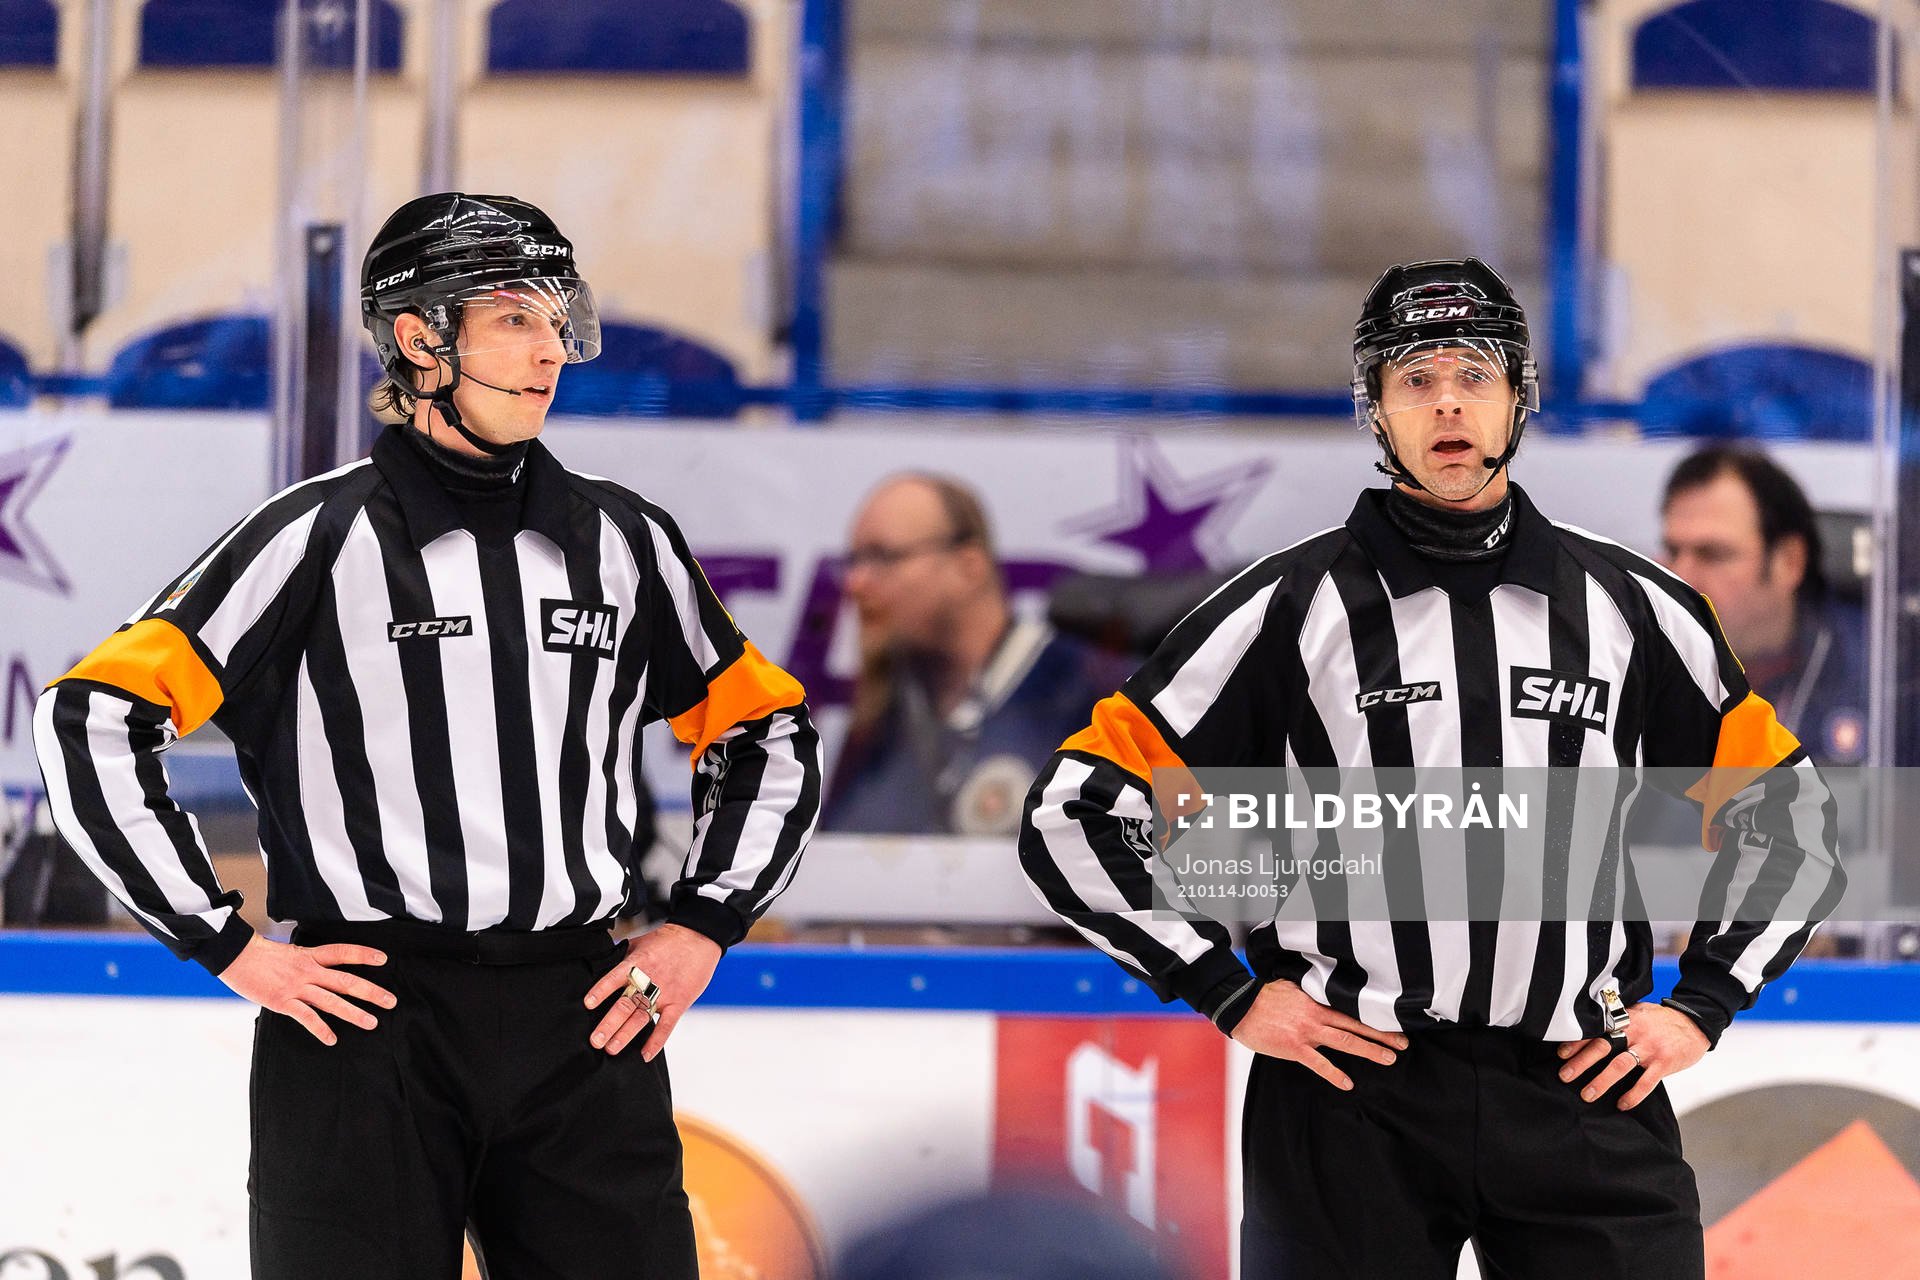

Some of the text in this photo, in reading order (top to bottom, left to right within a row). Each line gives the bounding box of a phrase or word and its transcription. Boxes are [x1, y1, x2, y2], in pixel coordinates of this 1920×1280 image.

[523, 244, 568, 257] CCM
[376, 267, 416, 291] CCM
[1405, 305, 1469, 322] CCM
[391, 619, 468, 639] CCM
[547, 608, 615, 650] SHL
[1359, 684, 1437, 709] CCM
[1517, 676, 1606, 723] SHL
